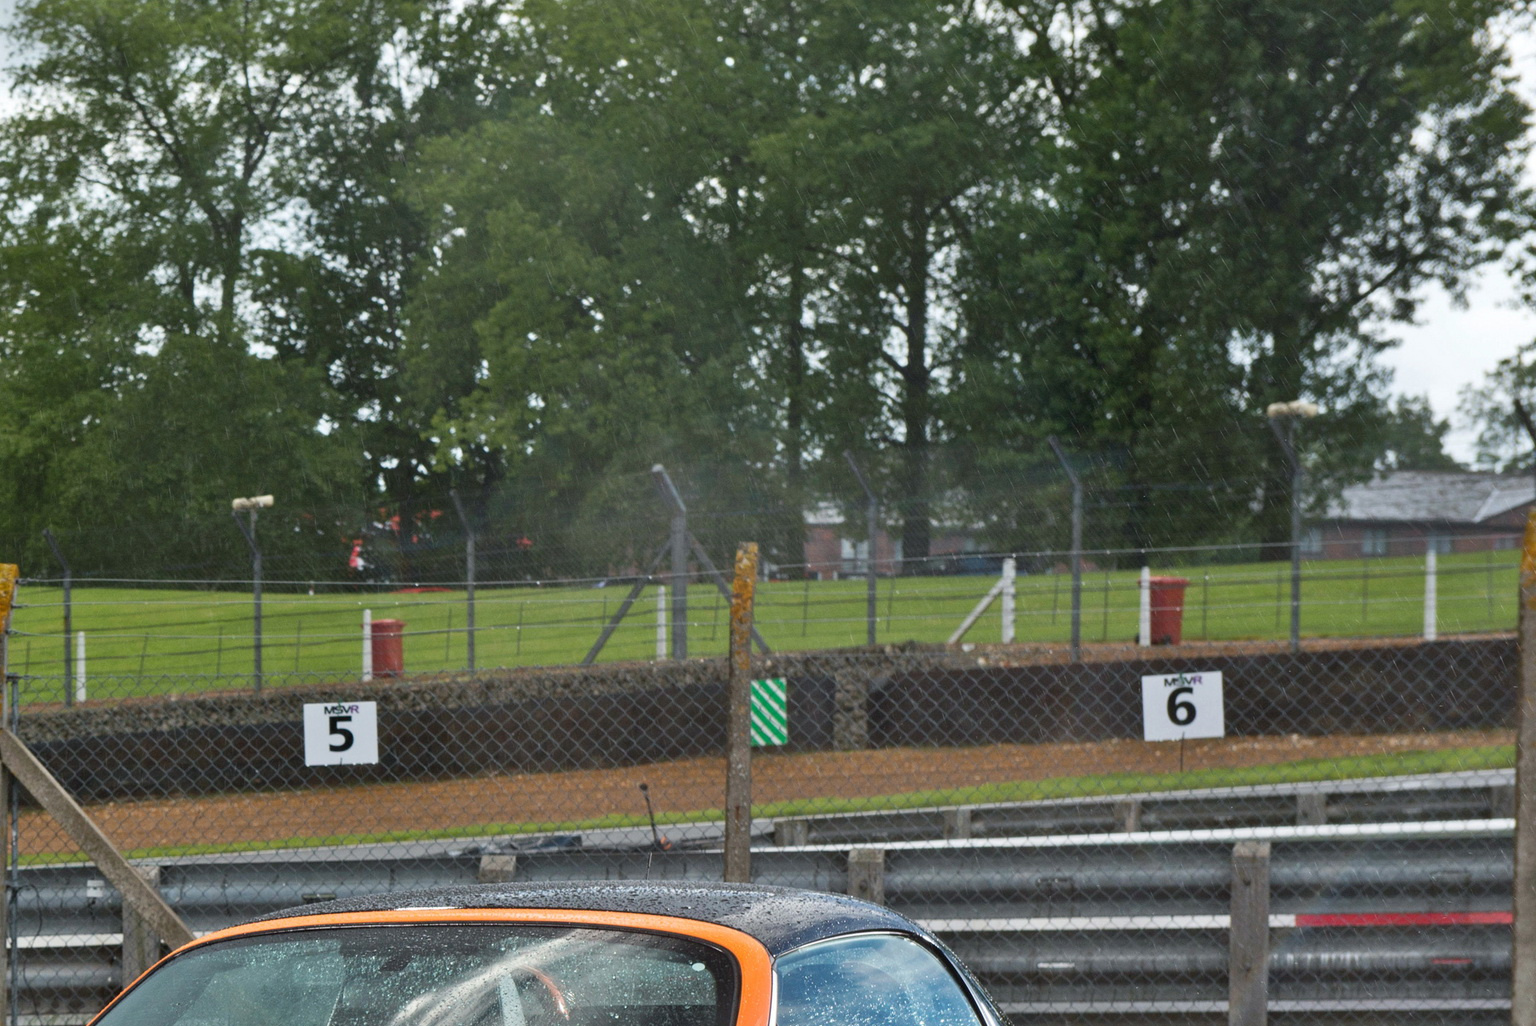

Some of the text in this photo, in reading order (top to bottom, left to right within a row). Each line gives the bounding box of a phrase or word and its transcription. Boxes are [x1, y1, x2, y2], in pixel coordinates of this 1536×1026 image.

[324, 705, 359, 714] MSVR
[1167, 687, 1196, 726] 6
[329, 715, 354, 752] 5
